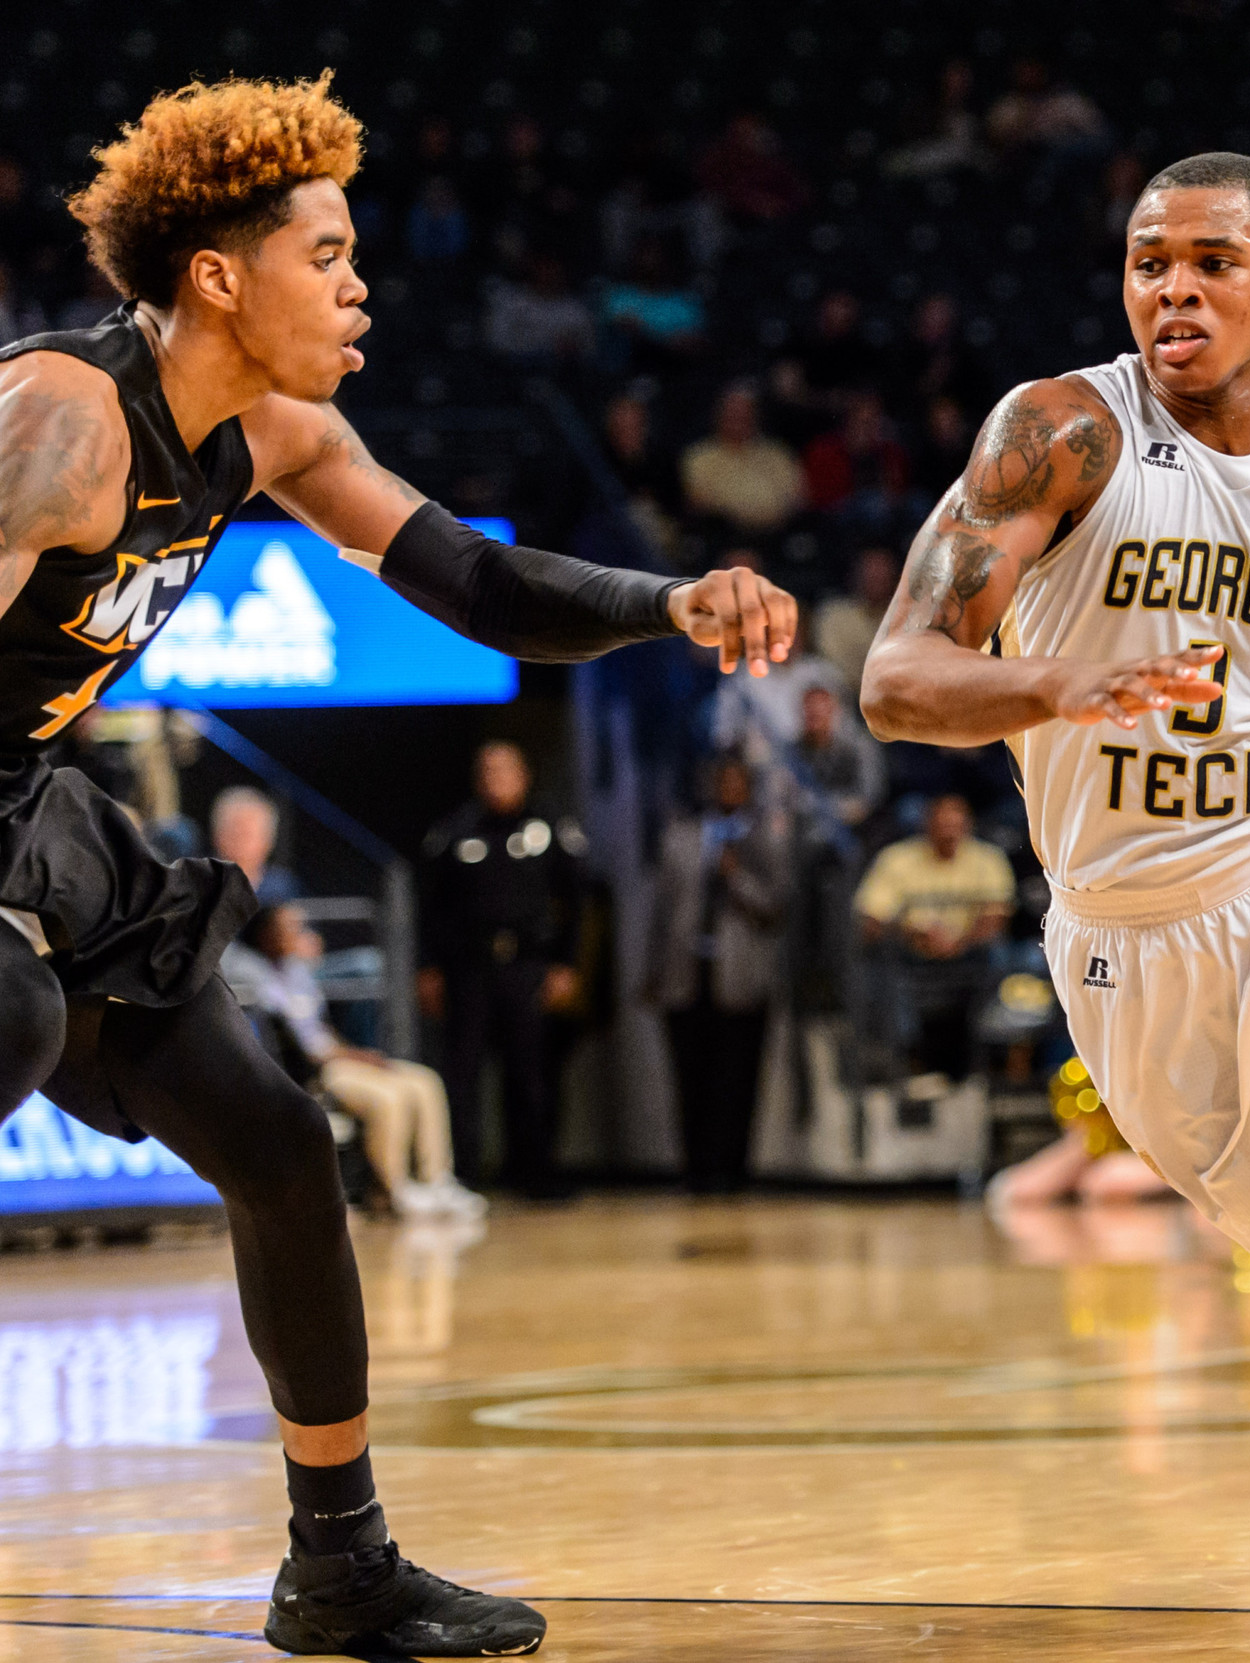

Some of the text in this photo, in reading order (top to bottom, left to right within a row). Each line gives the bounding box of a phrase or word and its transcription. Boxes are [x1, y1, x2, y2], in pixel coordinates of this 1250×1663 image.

[1141, 456, 1185, 471] RUSSELL
[82, 553, 205, 643] VC
[1082, 977, 1116, 989] RUSSELL
